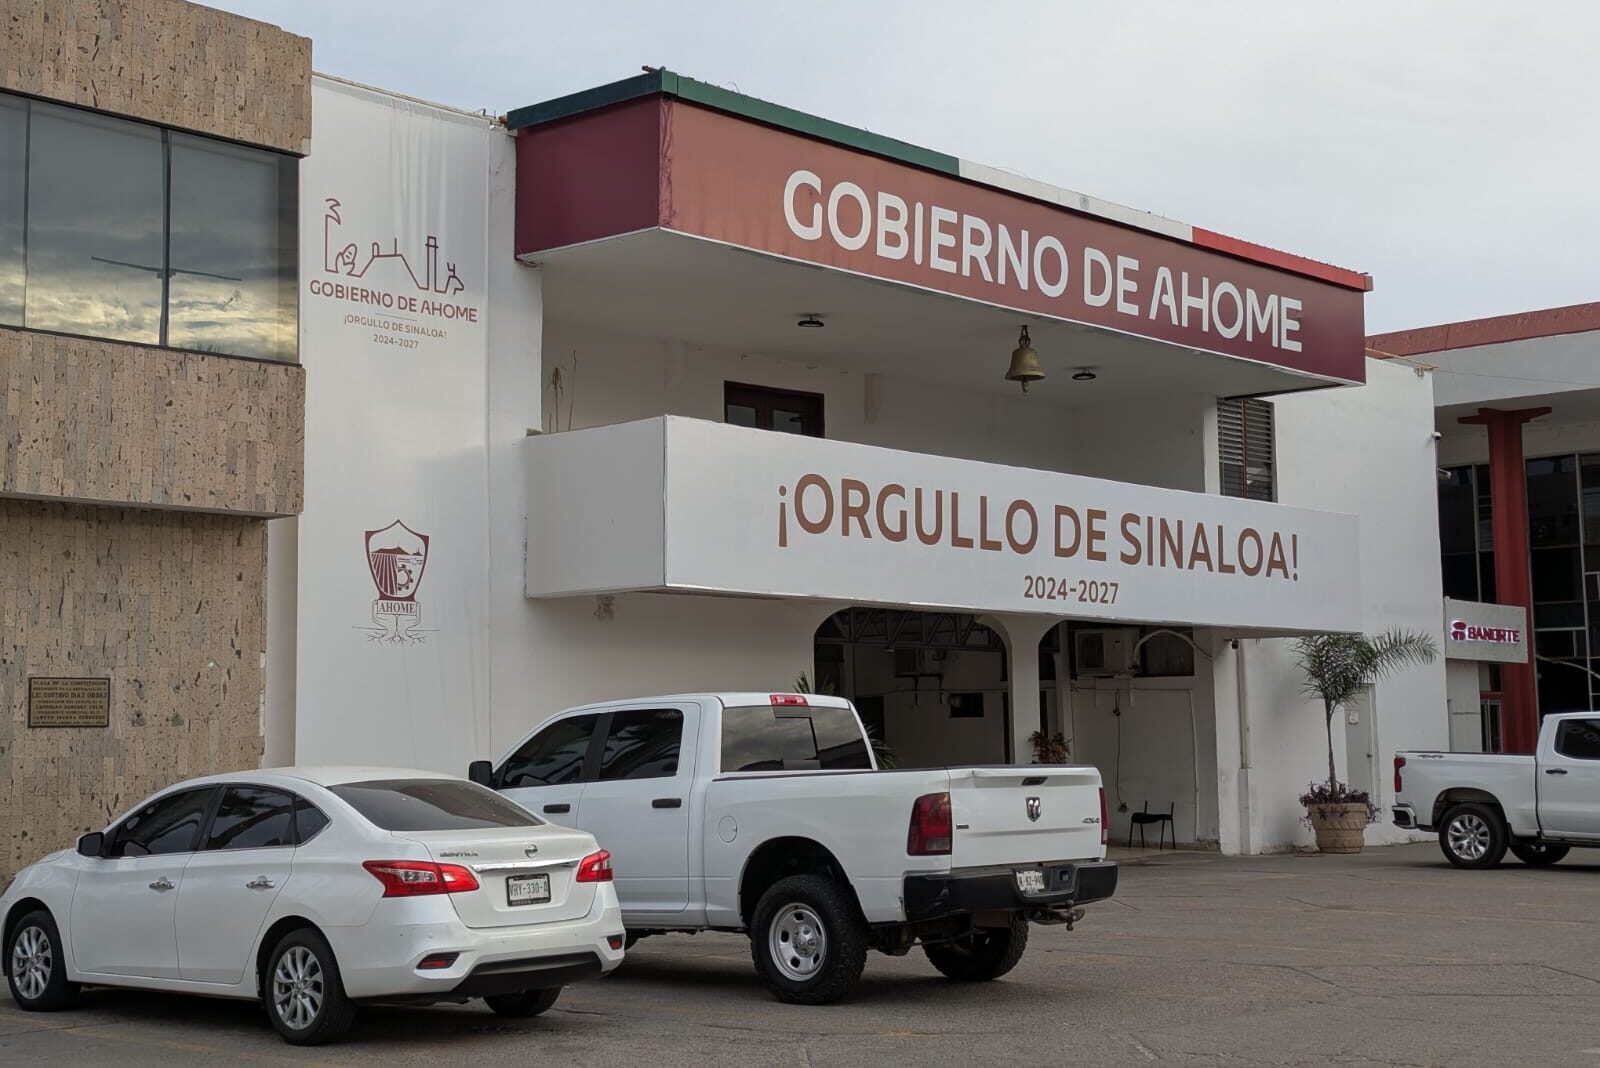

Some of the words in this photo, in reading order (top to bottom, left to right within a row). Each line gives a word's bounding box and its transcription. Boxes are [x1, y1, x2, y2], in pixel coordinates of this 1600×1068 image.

[783, 169, 1069, 298] GOBIERNO
[1084, 247, 1139, 316] DE
[1149, 266, 1303, 352] AHOME
[310, 279, 393, 308] GOBIERNO
[398, 296, 417, 312] DE
[420, 300, 478, 323] AHOME
[344, 314, 391, 330] ¡ORGULLO
[392, 322, 403, 332] DE
[405, 325, 447, 339] SINALOA!
[373, 334, 419, 349] 2024-2027
[777, 473, 1039, 555] ¡ORGULLO
[1054, 505, 1107, 561] DE
[1119, 513, 1299, 581] SINALOA!
[1023, 575, 1119, 605] 2024-2027
[379, 602, 416, 614] AHOME
[1467, 626, 1521, 643] BANORTE
